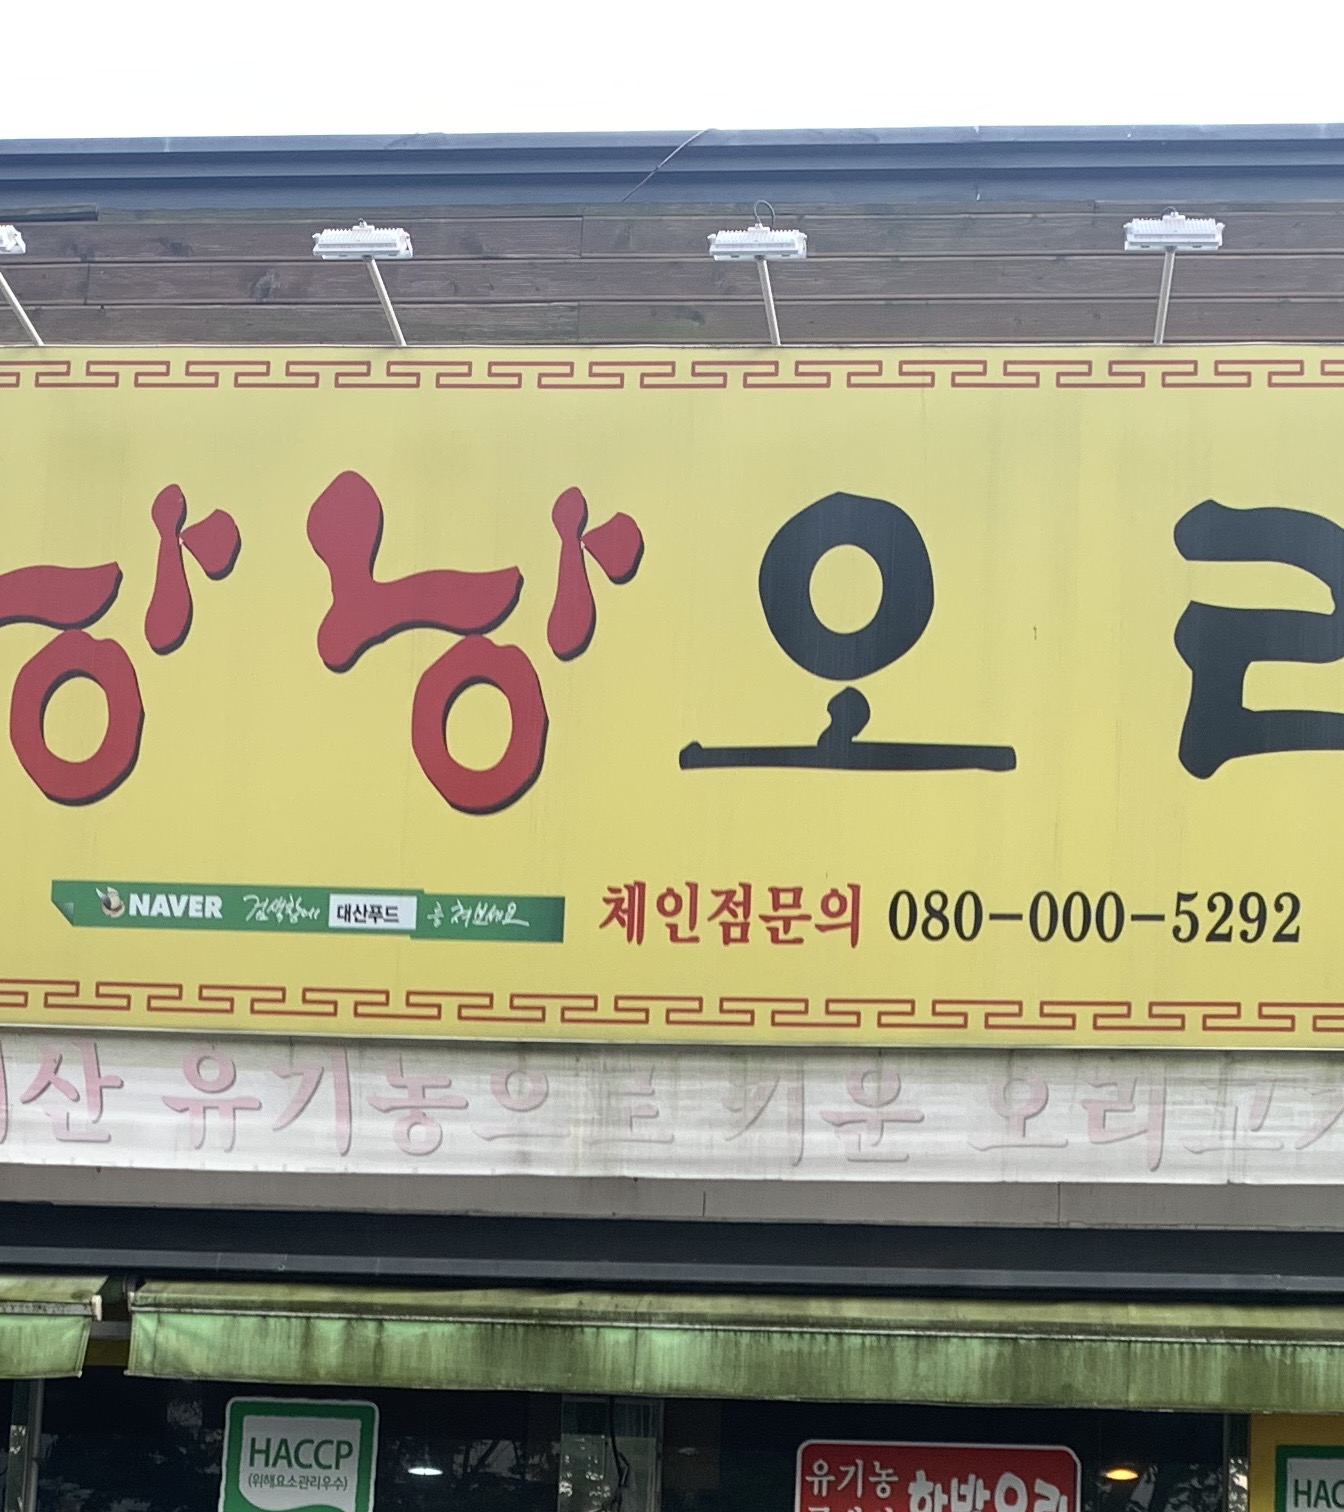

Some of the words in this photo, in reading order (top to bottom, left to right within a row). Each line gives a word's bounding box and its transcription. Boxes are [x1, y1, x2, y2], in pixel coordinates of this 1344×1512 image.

[129, 893, 223, 918] NAVER
[337, 904, 399, 923] 대산푸드
[599, 880, 862, 947] 체인점문의
[888, 888, 1302, 945] 080-000-5292
[248, 1437, 354, 1470] HACCP
[804, 1460, 899, 1499] 유기농
